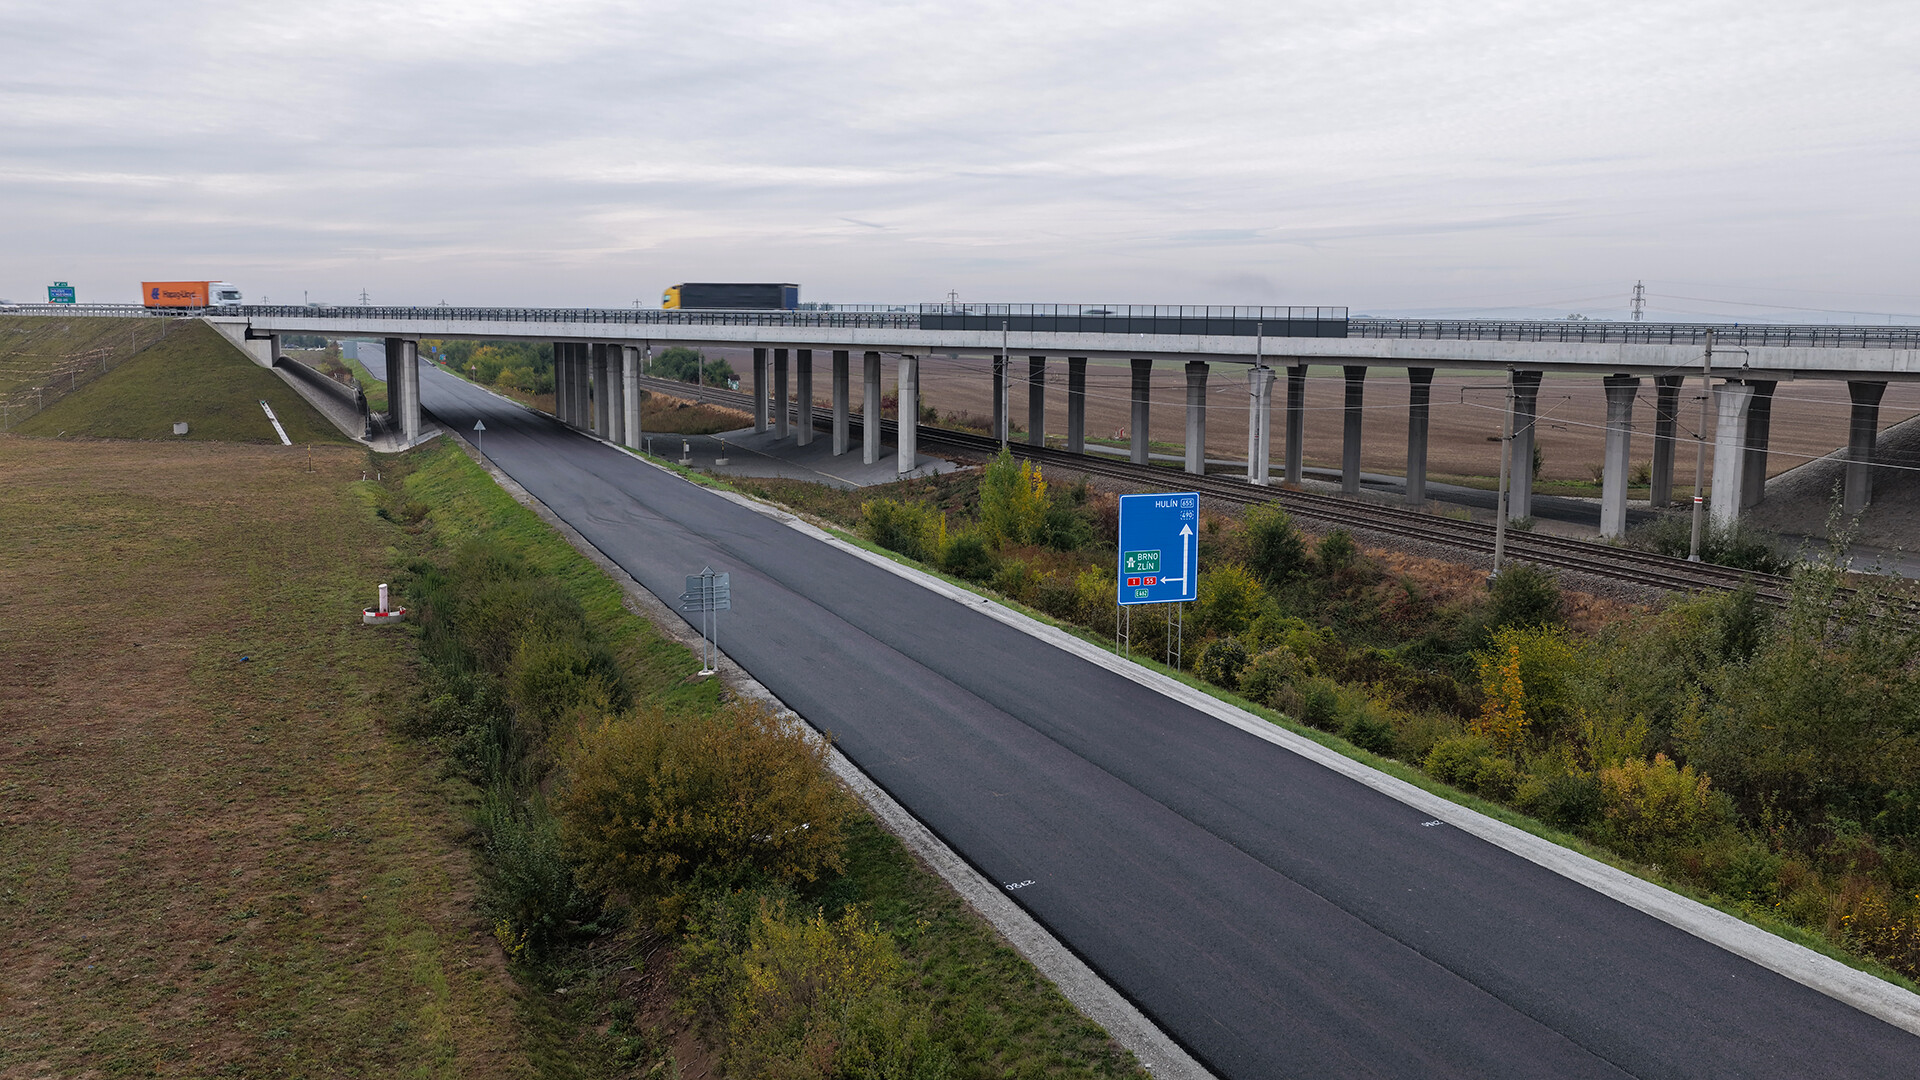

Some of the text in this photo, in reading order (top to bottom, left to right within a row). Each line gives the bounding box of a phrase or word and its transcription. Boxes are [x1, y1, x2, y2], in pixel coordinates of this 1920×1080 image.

[1155, 498, 1178, 508] HULÍN
[1137, 552, 1159, 561] BRNO
[1137, 561, 1155, 570] ZLÍN
